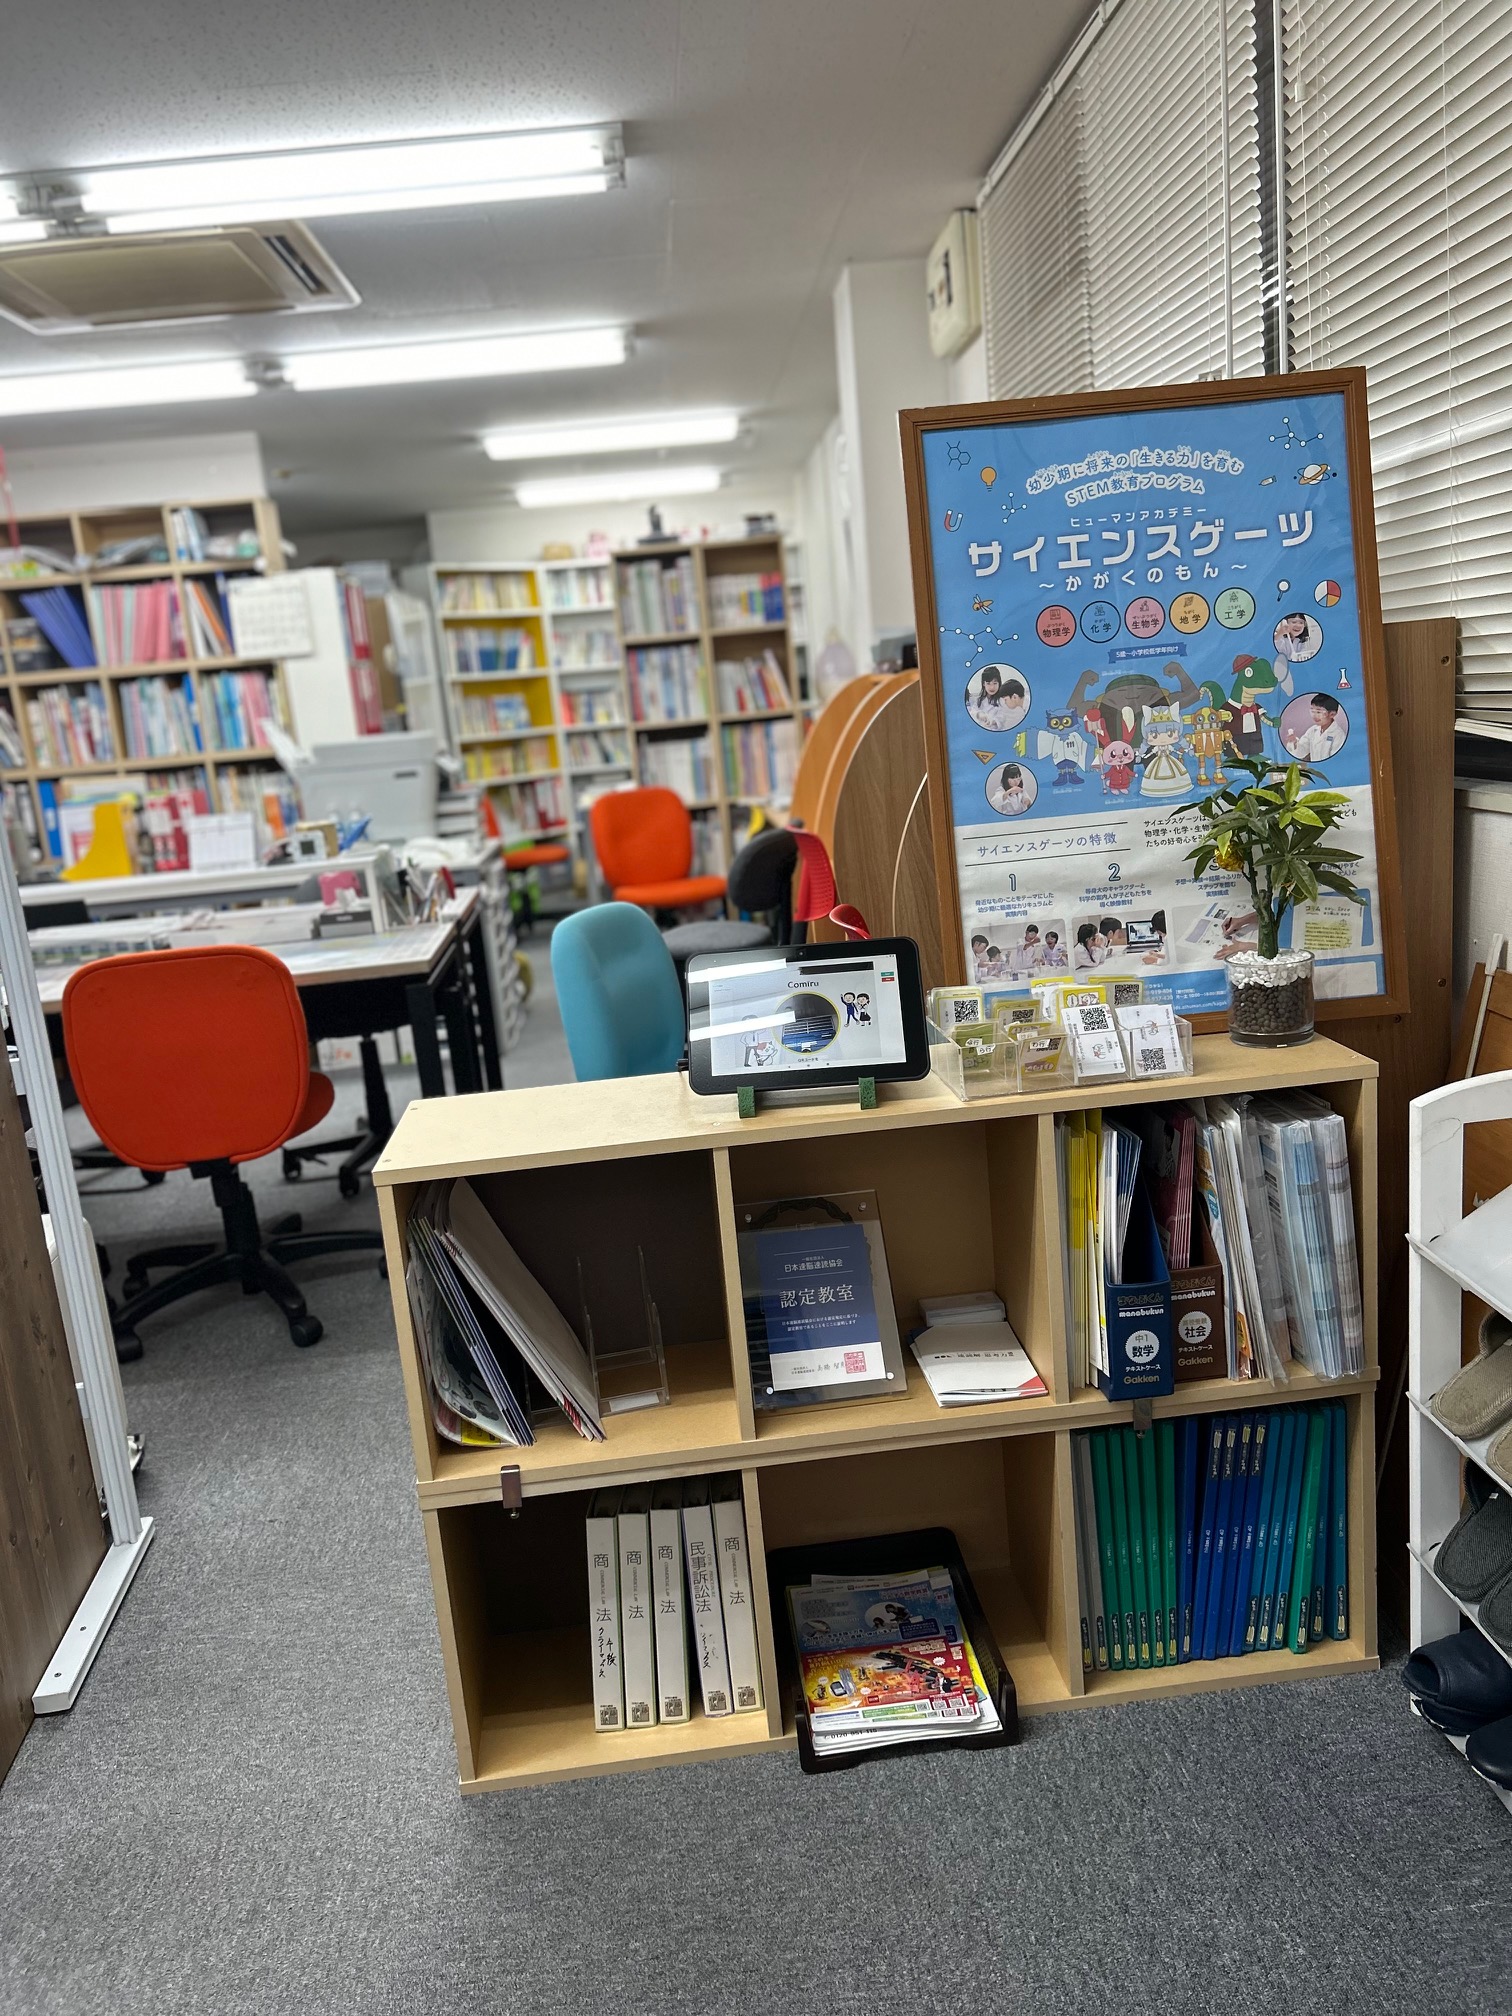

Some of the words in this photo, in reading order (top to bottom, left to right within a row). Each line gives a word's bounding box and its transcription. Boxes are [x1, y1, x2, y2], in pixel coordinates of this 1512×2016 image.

[1066, 474, 1204, 505] STEM教育プログラム
[1070, 507, 1207, 528] ヒューマンアカデミー
[968, 510, 1314, 577] サイエンスゲーツ
[1179, 614, 1202, 625] 地学
[1224, 609, 1246, 621] 工学
[1090, 623, 1112, 634] 化学
[1131, 619, 1160, 630] 生物学
[1042, 627, 1070, 638] 物理学
[977, 831, 1118, 858] サイエンスゲーツの特徴
[1108, 863, 1121, 882] 2
[1008, 873, 1017, 892] 1
[787, 980, 819, 989] Comiru
[779, 1284, 855, 1309] 認定教室
[1171, 1289, 1216, 1301] manabukun
[1118, 1307, 1164, 1318] manabukun
[1184, 1326, 1206, 1339] 社会
[1132, 1344, 1155, 1358] 数学
[1178, 1344, 1213, 1353] テキストケース
[1125, 1363, 1161, 1372] テキストケース
[1177, 1356, 1214, 1367] Gakken
[1123, 1375, 1160, 1385] Gakken
[690, 1541, 712, 1614] 民事訴訟法
